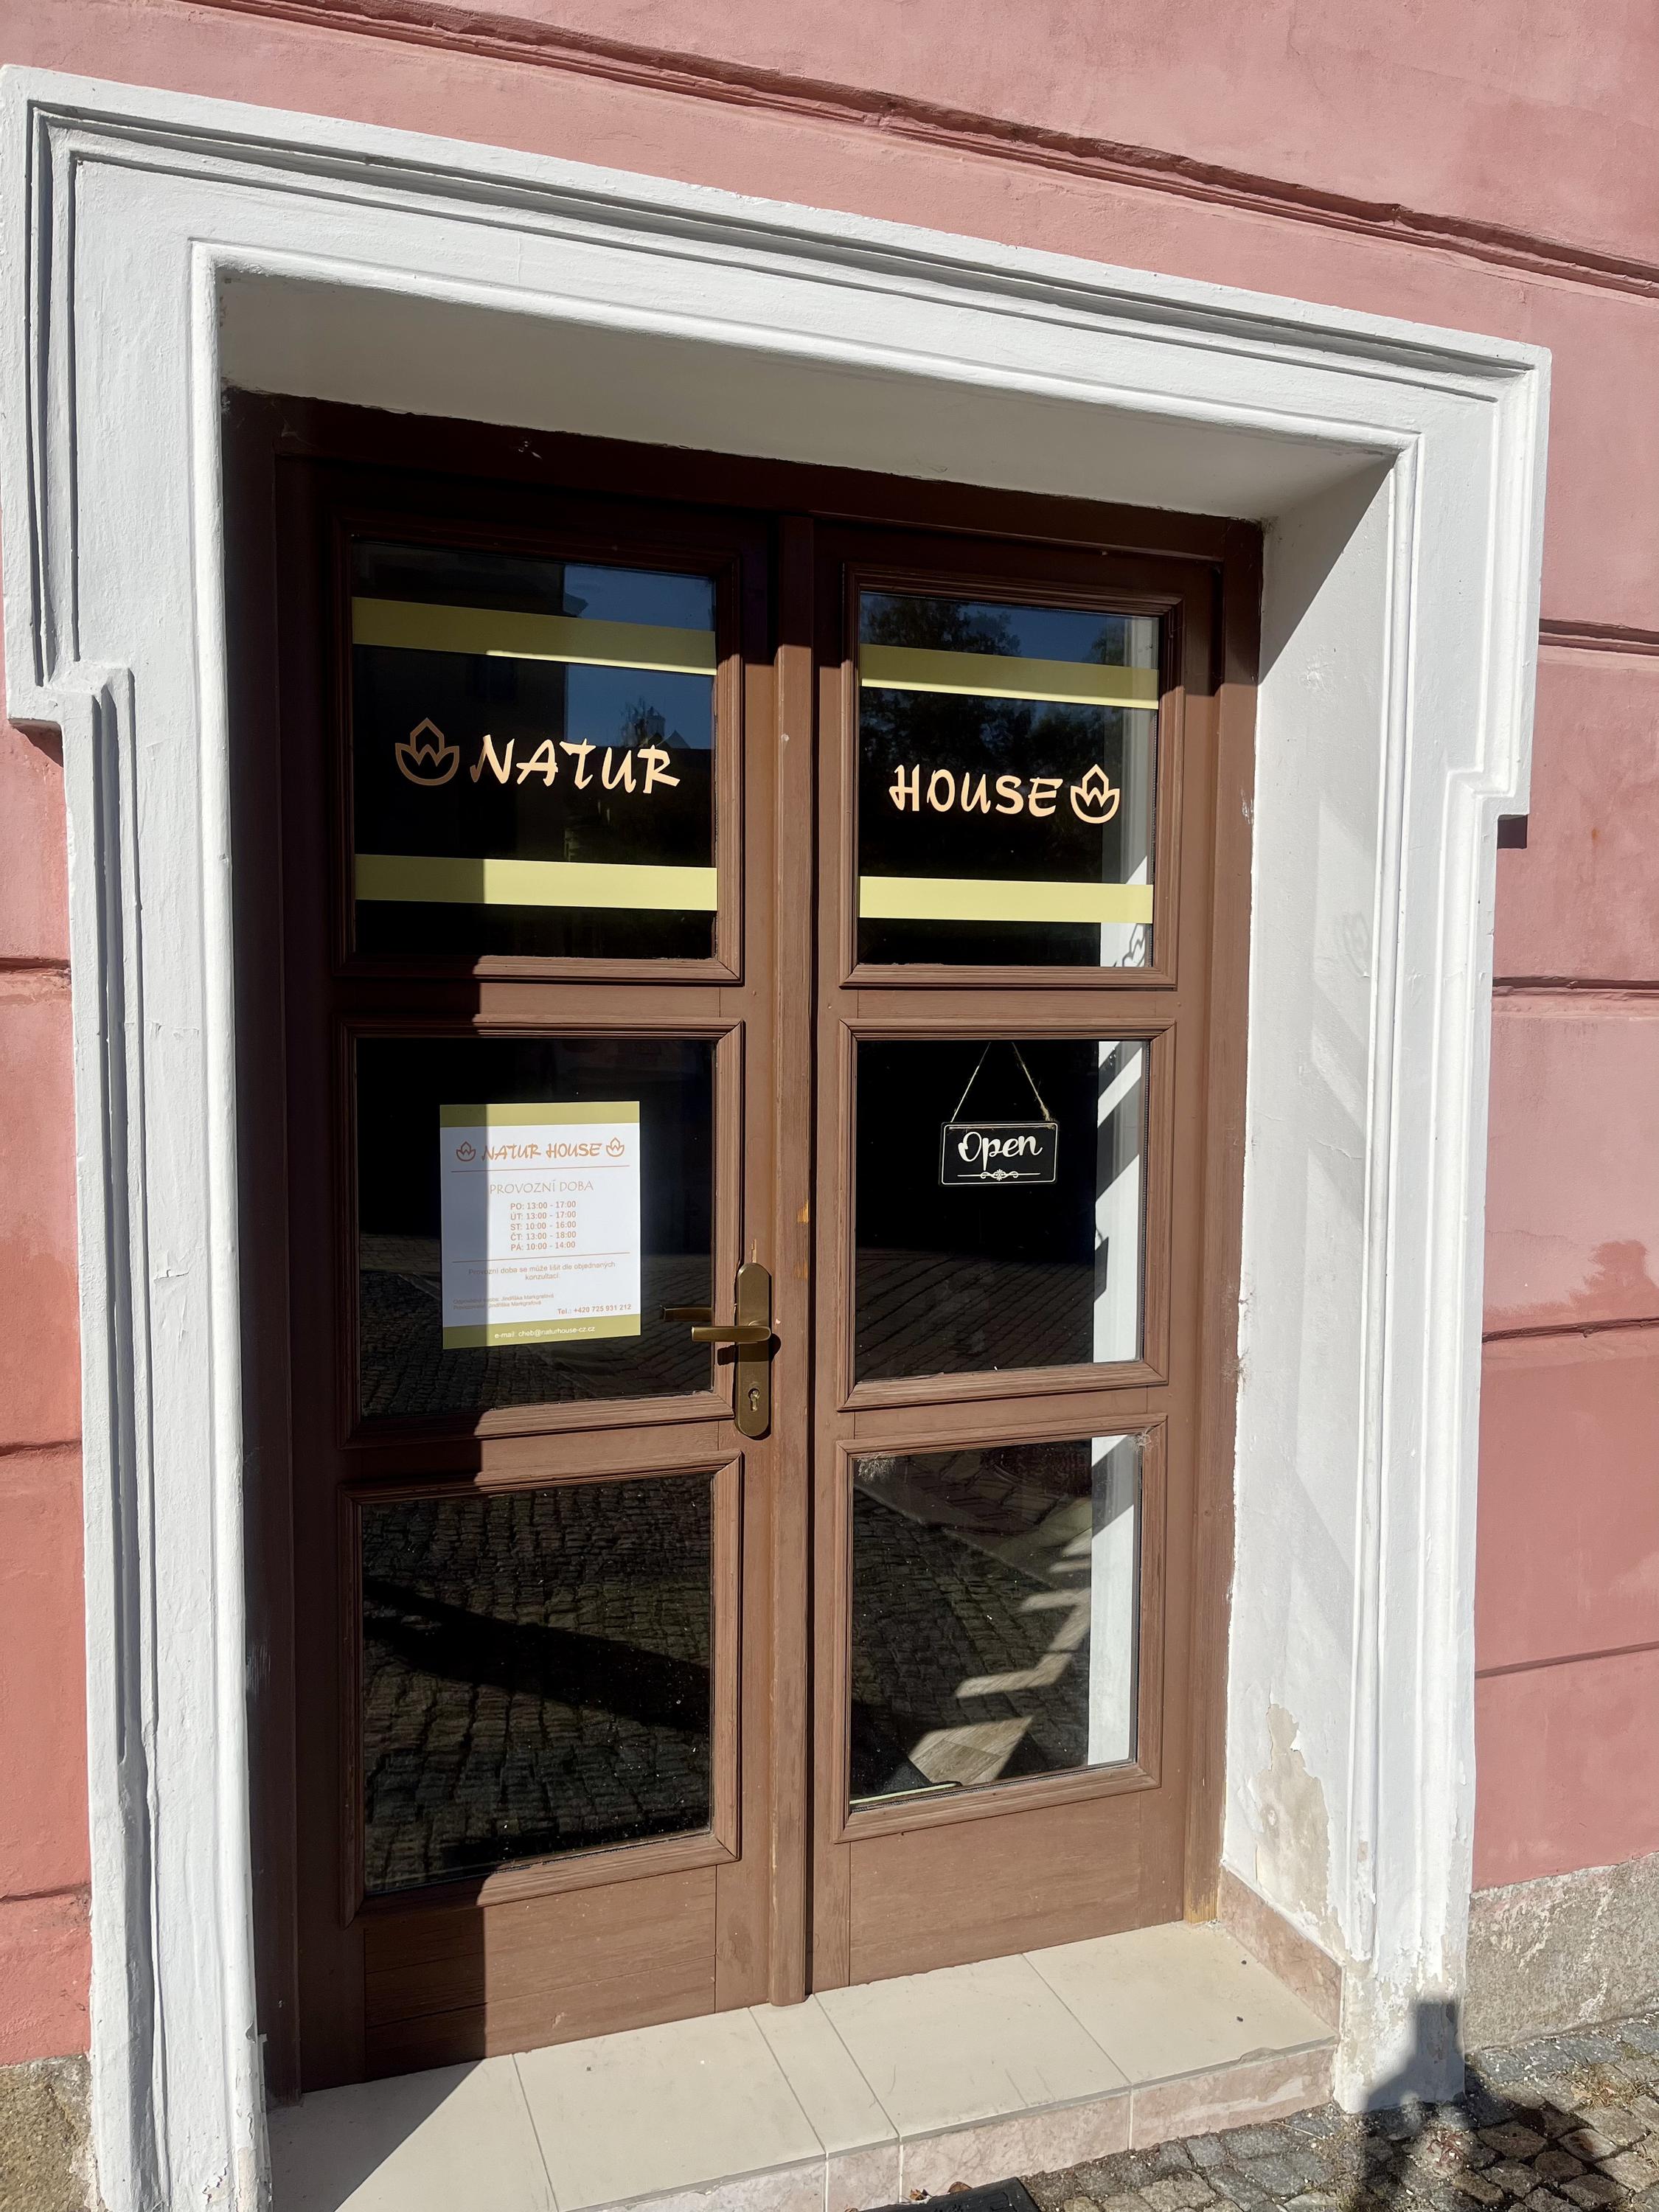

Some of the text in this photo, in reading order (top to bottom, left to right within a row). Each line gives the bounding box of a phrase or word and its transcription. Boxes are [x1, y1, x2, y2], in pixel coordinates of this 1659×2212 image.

[470, 734, 1063, 817] NATUR HOUSE
[481, 1143, 602, 1161] NATUR HOUSE
[958, 1131, 1043, 1171] Open
[490, 1180, 594, 1194] PROVOZNÍ DOBA
[555, 1200, 577, 1208] 17:00
[510, 1233, 524, 1241] ČT:
[526, 1232, 547, 1240] 13:00
[555, 1231, 577, 1239] 18:00
[526, 1242, 547, 1251] 10:00
[555, 1241, 576, 1249] 14:00
[574, 1261, 616, 1270] objednaných
